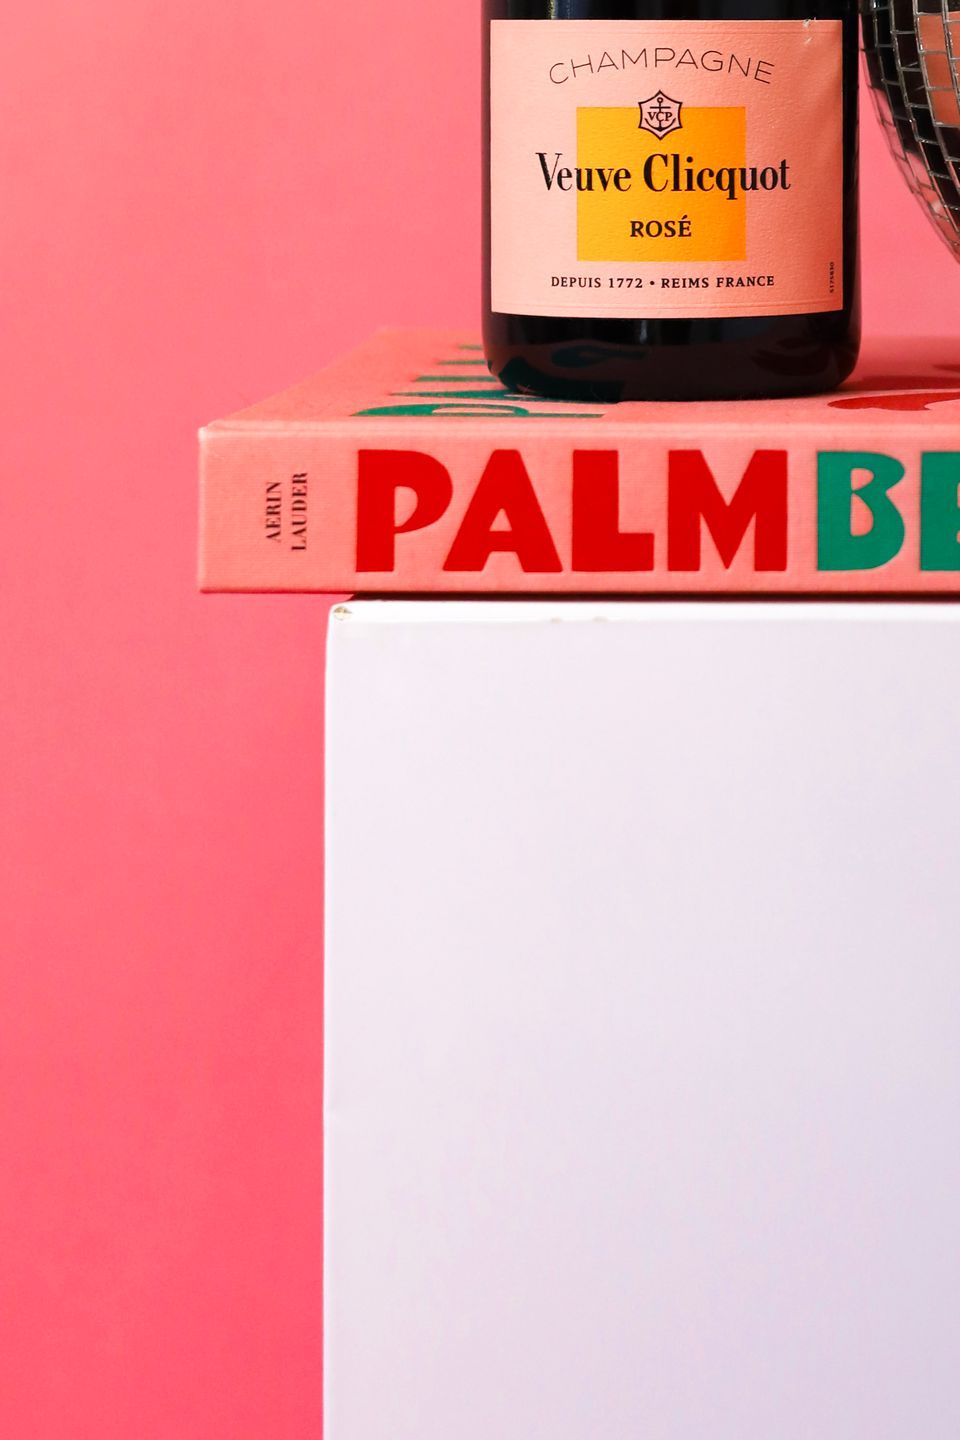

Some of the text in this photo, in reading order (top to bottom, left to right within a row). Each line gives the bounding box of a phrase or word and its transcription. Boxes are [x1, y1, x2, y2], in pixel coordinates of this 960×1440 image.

[549, 47, 775, 85] CHAMPAGNE
[647, 111, 673, 122] VCP
[535, 152, 791, 200] Veuve Clicquot
[630, 214, 692, 238] ROSÉ
[551, 275, 775, 289] DEPUIS 1772 REIMS FRANCE
[265, 481, 282, 543] AERIN
[291, 472, 308, 550] LAUDER
